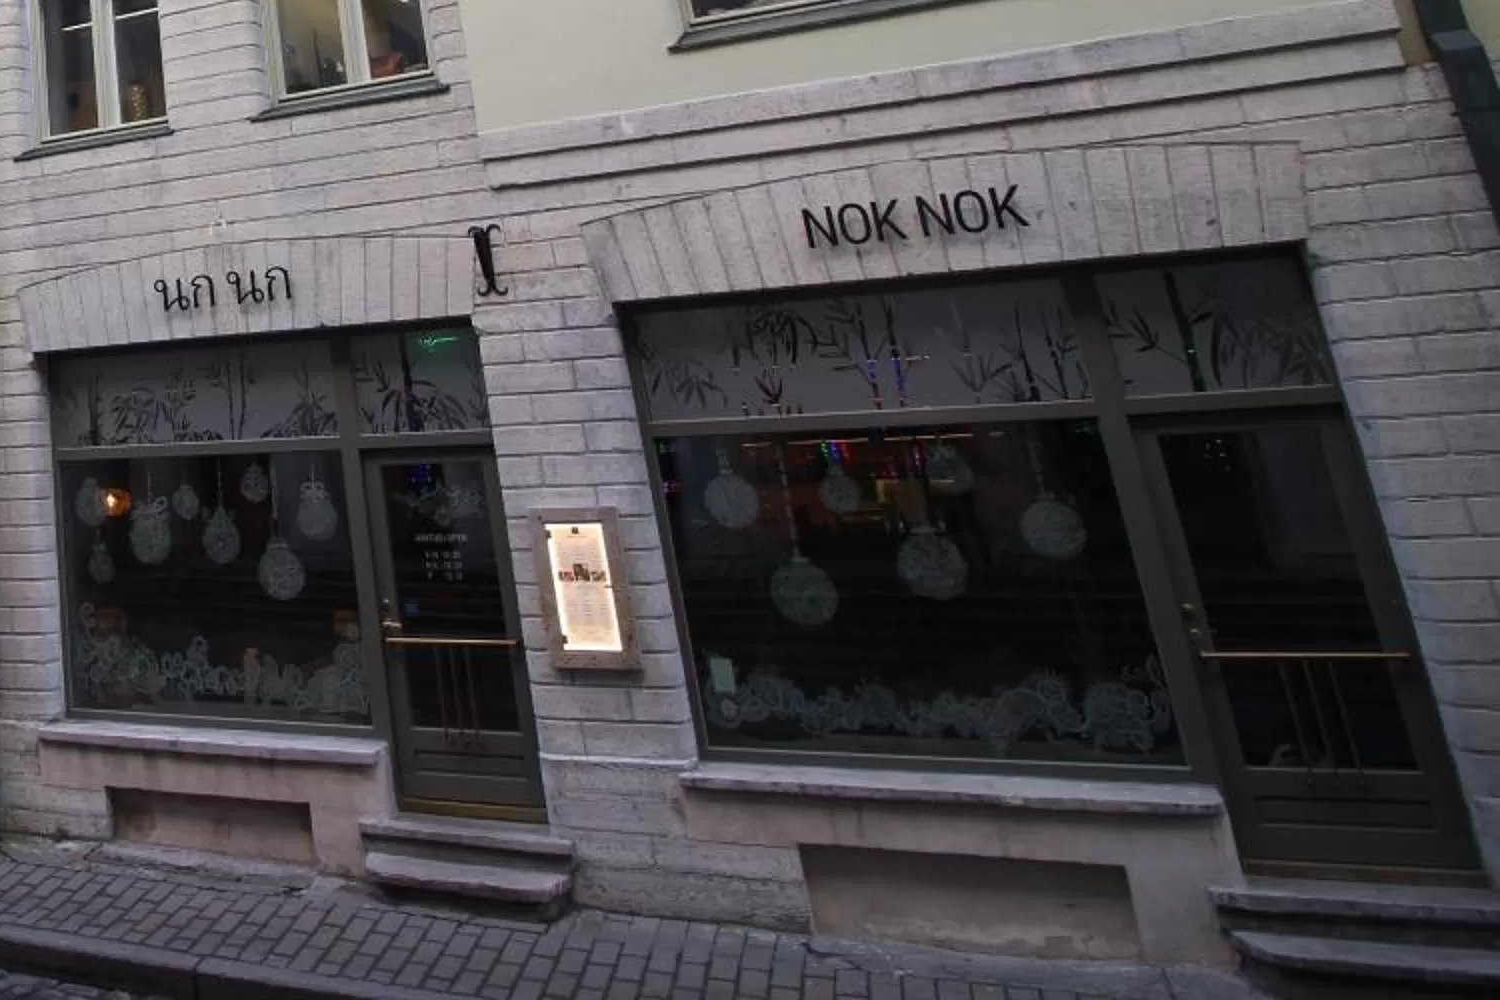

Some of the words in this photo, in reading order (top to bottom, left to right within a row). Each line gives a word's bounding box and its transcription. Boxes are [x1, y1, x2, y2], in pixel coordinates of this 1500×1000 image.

[801, 198, 908, 249] NOK
[915, 184, 1031, 237] NOK
[153, 274, 216, 312] นก
[226, 265, 292, 305] นก
